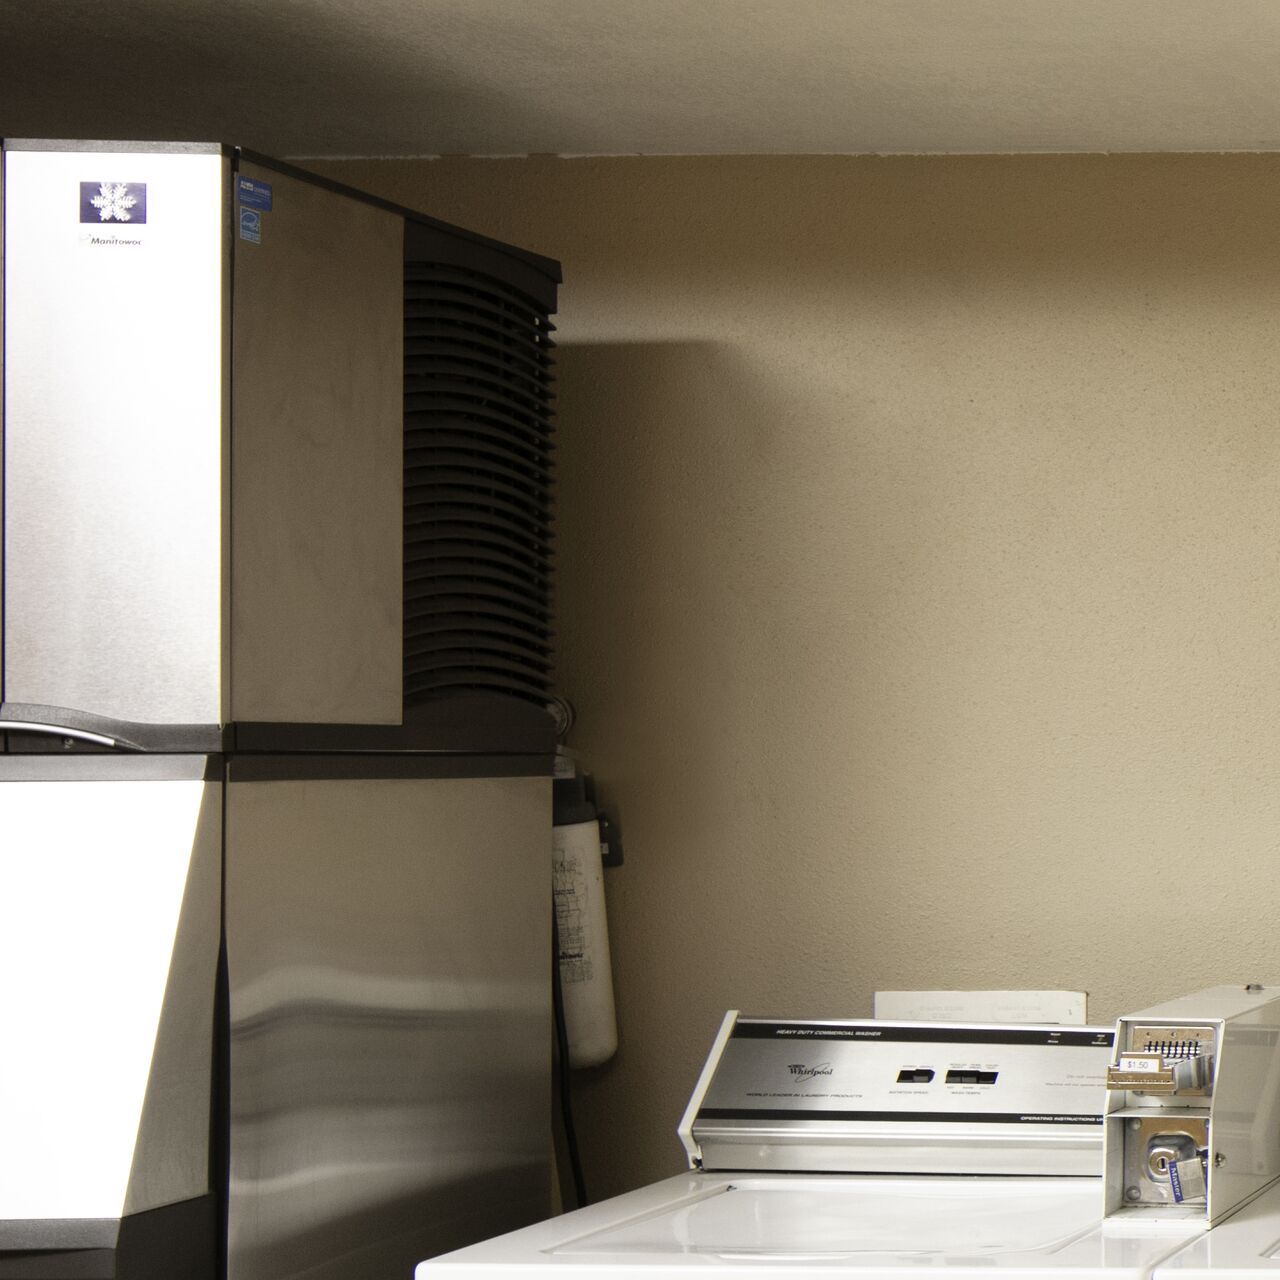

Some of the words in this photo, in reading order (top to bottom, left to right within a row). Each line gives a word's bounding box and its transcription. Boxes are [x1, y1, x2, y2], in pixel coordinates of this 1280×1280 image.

[90, 236, 142, 246] Manitowoc
[1127, 1060, 1149, 1070] $1.50
[789, 1066, 834, 1079] Whirlpool
[1170, 1166, 1182, 1198] Master
